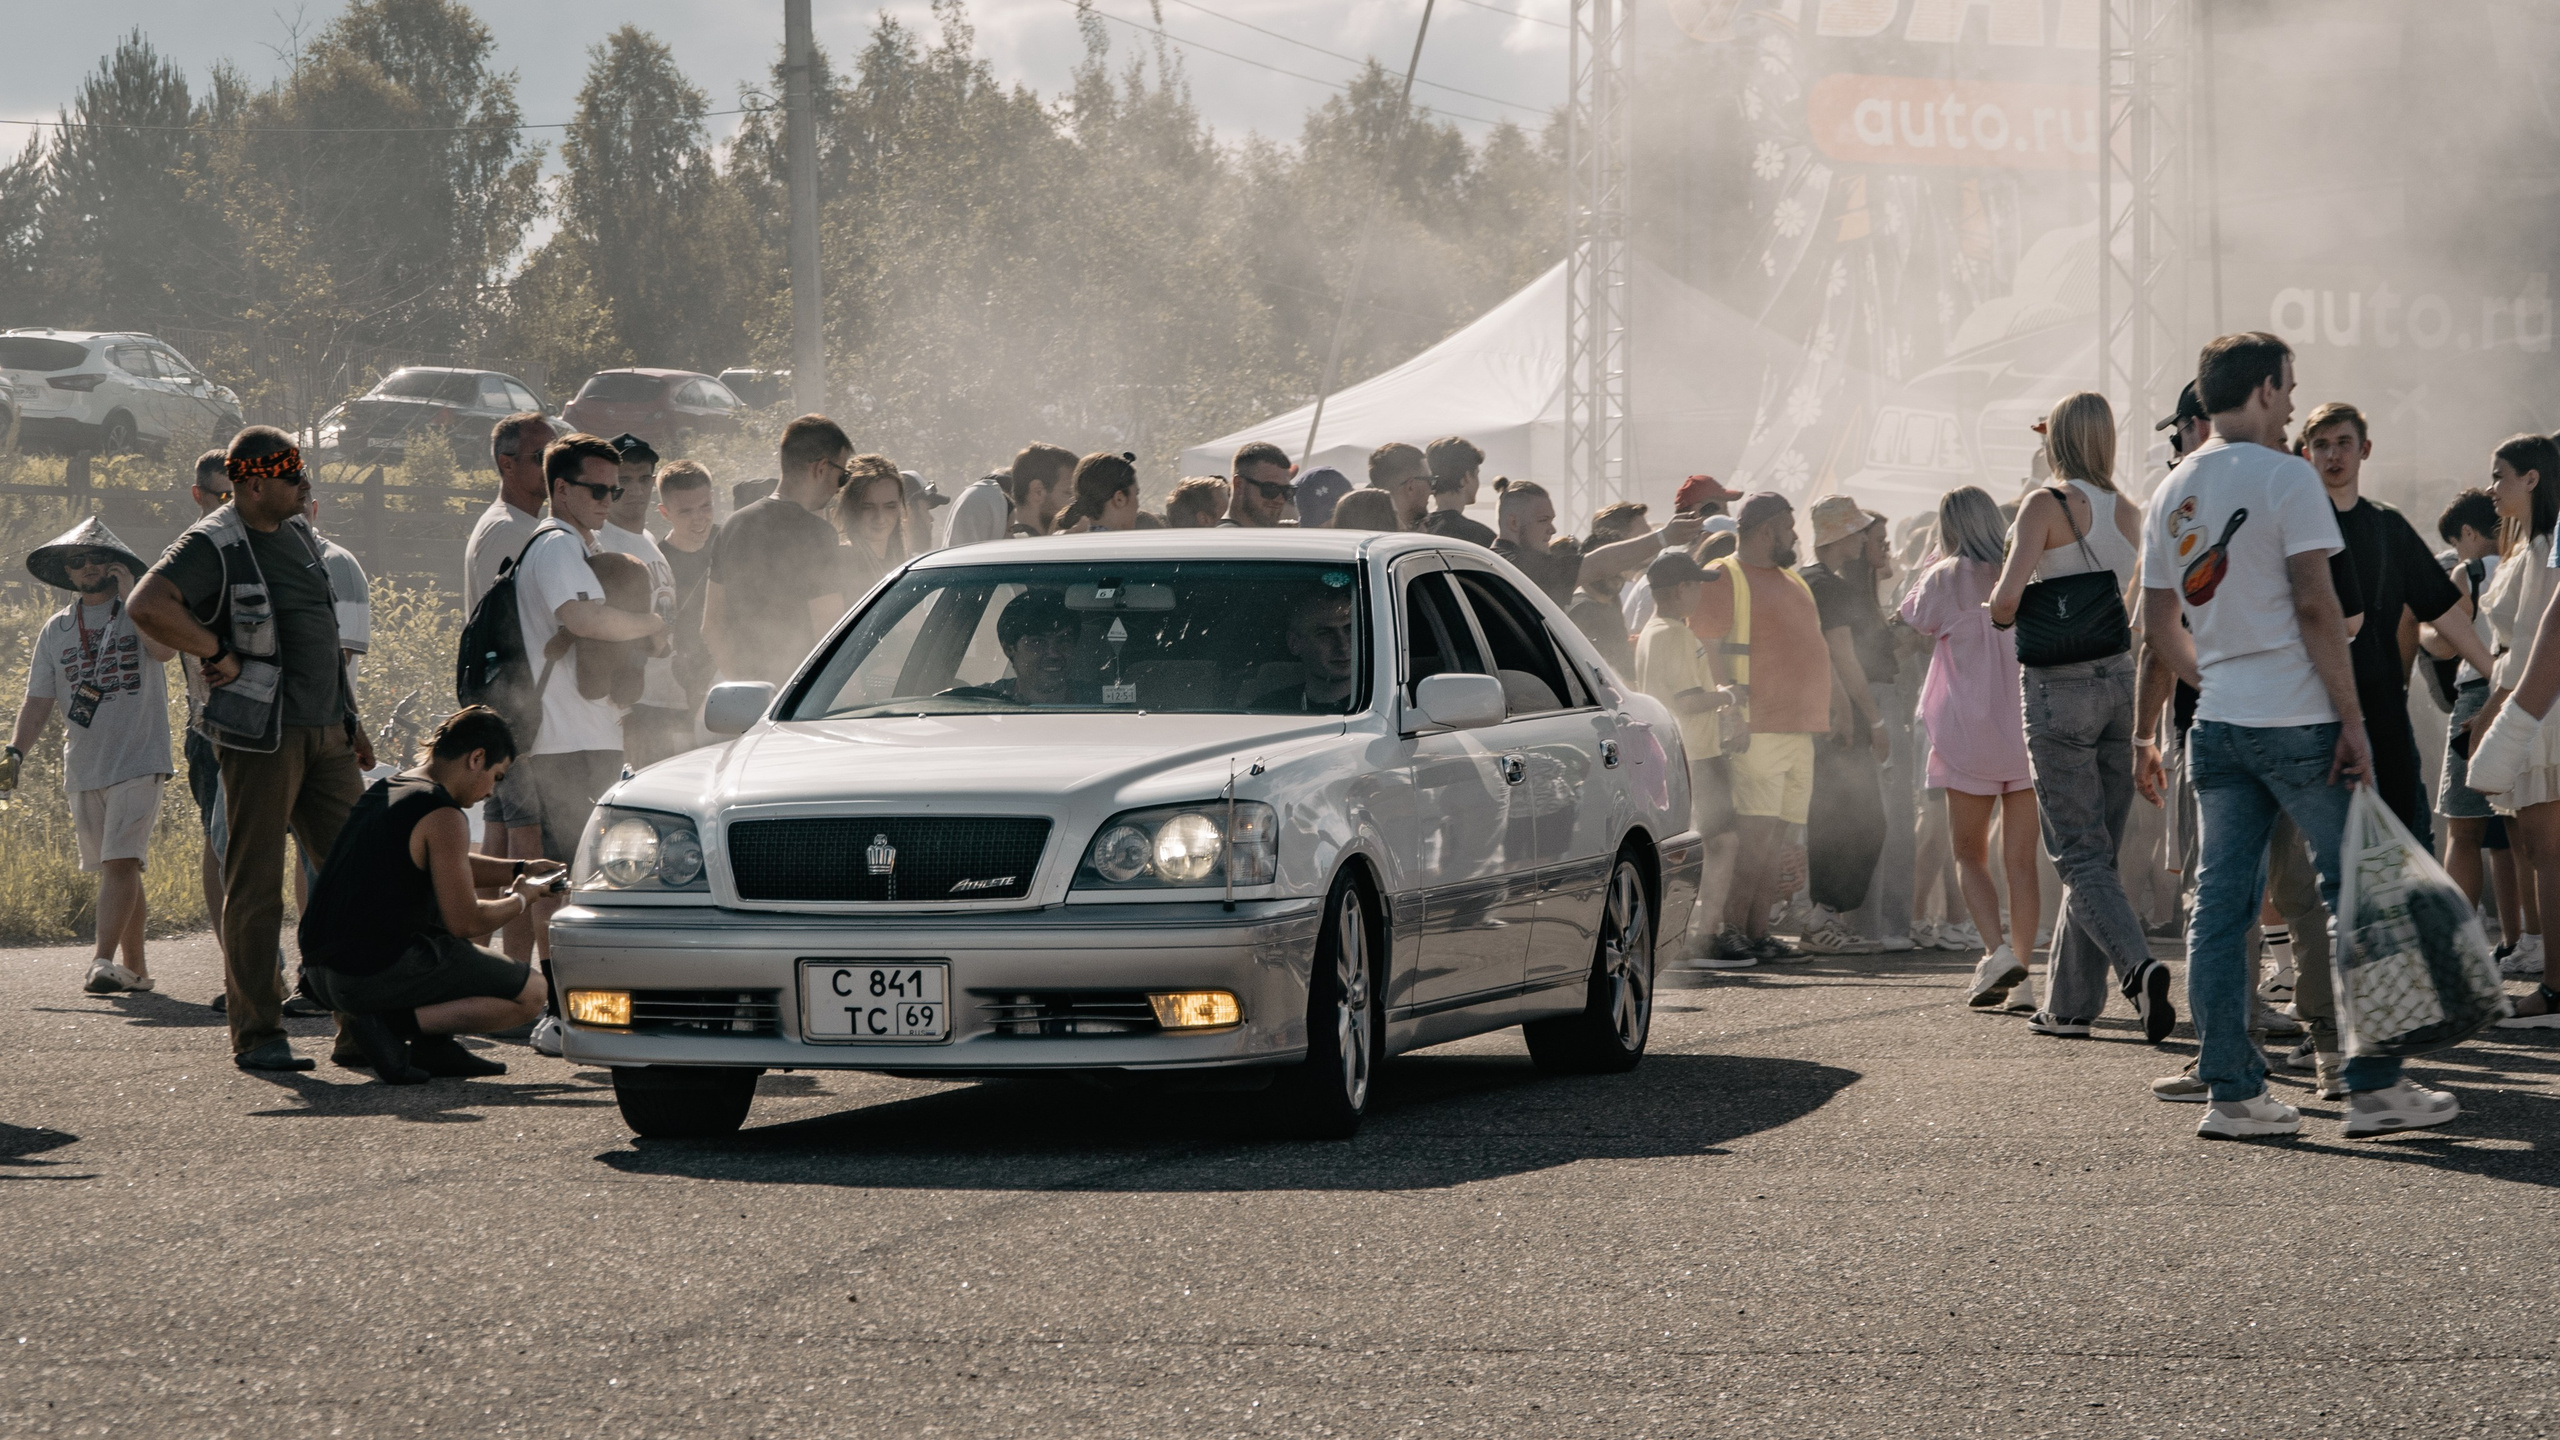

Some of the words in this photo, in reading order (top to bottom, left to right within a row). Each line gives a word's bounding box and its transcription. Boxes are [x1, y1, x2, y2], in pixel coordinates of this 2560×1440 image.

[1852, 93, 2098, 154] auto.ru
[2269, 279, 2553, 352] auto.ru
[948, 876, 1017, 893] ATHLETE
[869, 969, 922, 998] 841
[905, 1005, 934, 1027] 69
